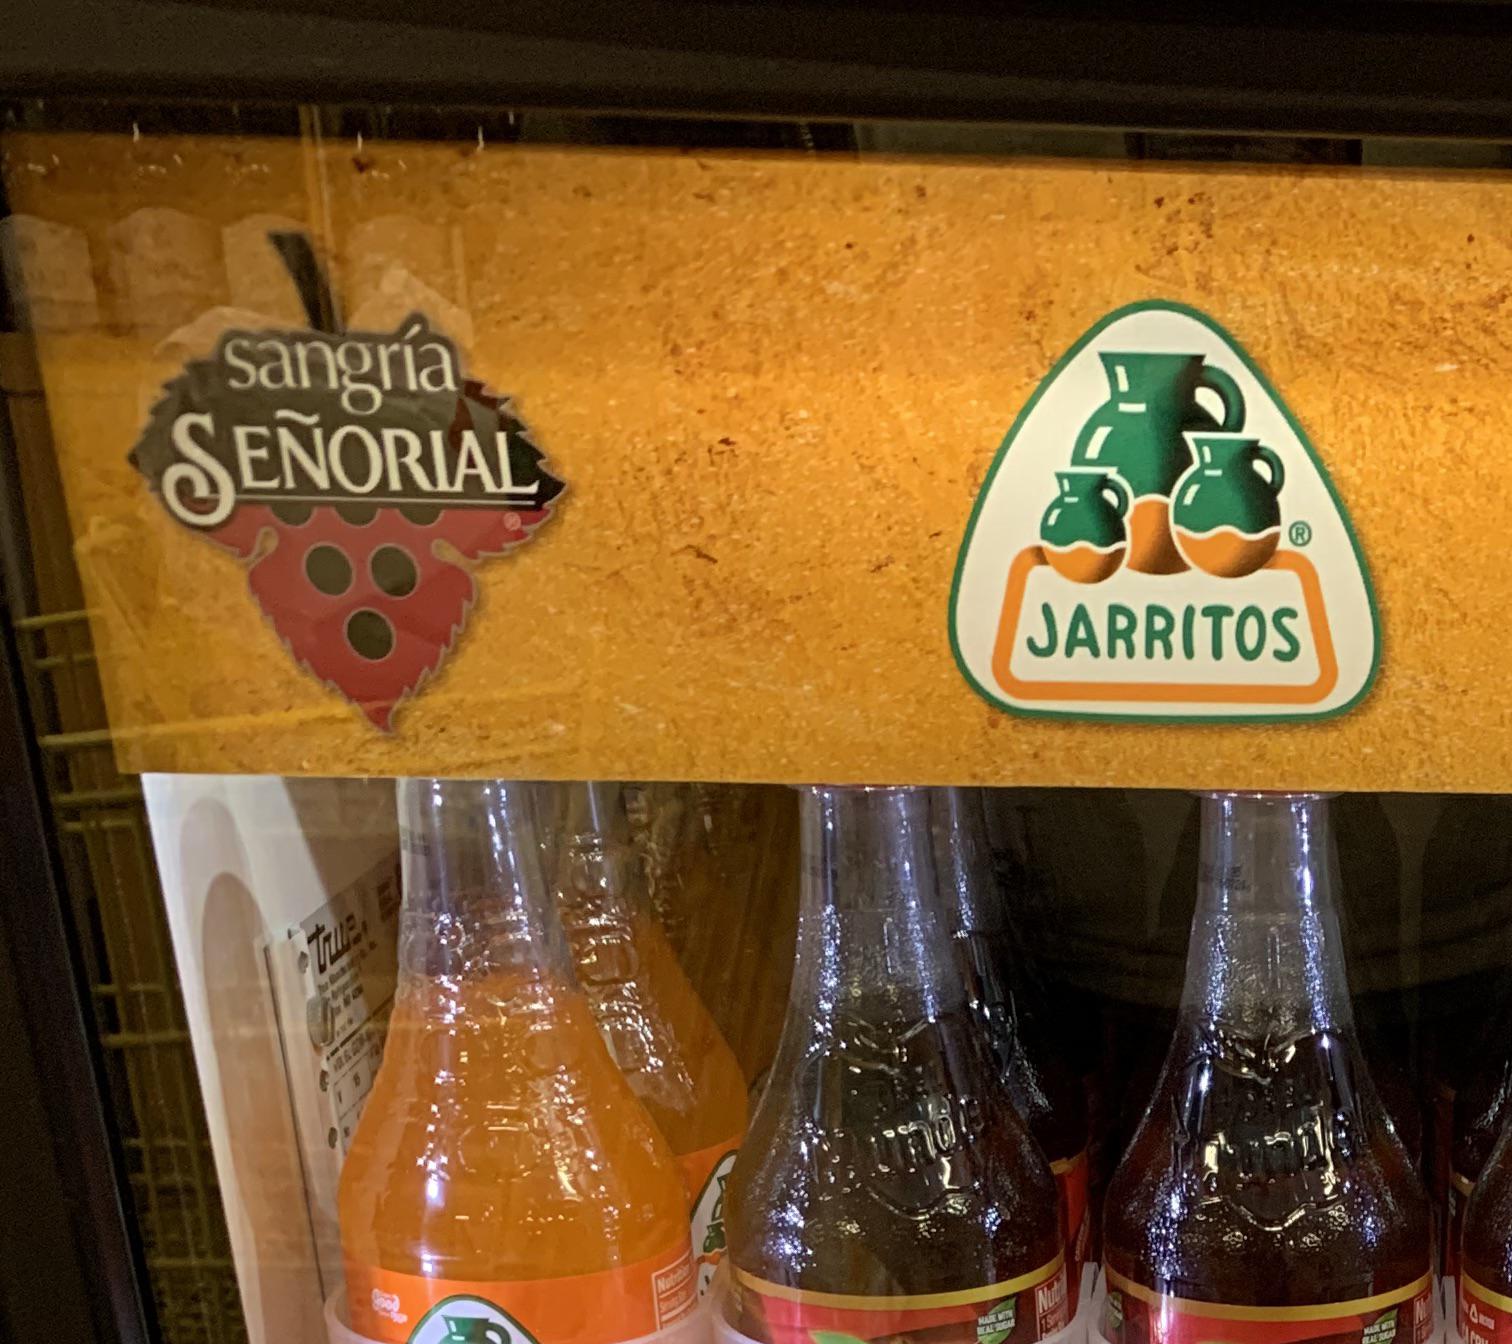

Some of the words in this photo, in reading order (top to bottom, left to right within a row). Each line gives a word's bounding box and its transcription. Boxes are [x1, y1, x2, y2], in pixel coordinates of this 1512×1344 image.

[223, 323, 459, 416] sangría
[161, 409, 540, 528] SEÑORIAL
[1026, 602, 1301, 662] JARRITOS
